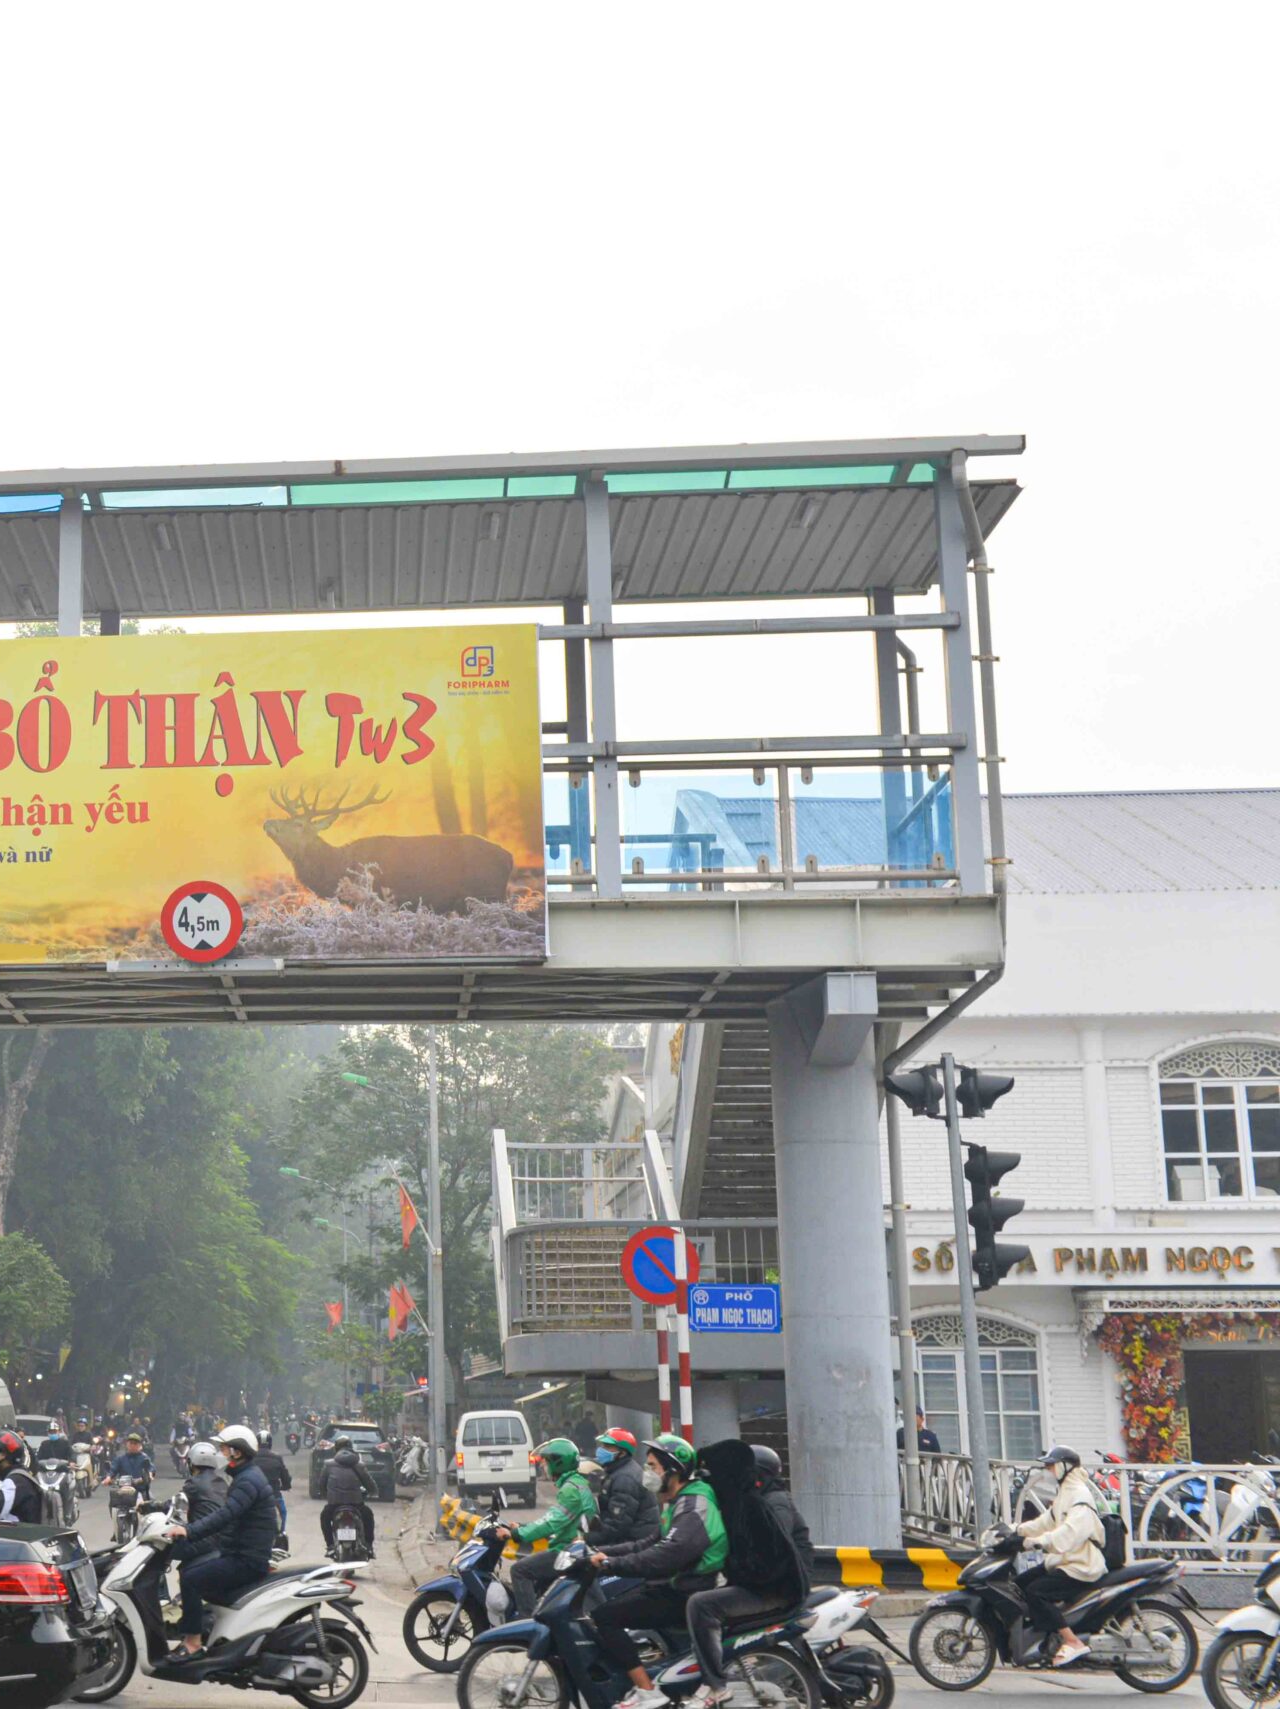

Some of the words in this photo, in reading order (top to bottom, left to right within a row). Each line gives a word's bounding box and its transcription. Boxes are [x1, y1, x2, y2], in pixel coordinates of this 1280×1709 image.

[447, 680, 510, 689] FORIPHARM
[92, 671, 307, 797] THẬN
[84, 783, 151, 832] yếu
[24, 847, 53, 863] nữ
[178, 906, 220, 938] 4,5m
[912, 1238, 956, 1272] SỐ
[1053, 1246, 1149, 1280] PHẠM
[1164, 1246, 1255, 1280] NGỌC
[725, 1289, 754, 1301] PHỐ
[696, 1307, 719, 1327] PHẠM
[722, 1308, 744, 1328] NGỌC
[746, 1308, 773, 1328] THẠCH
